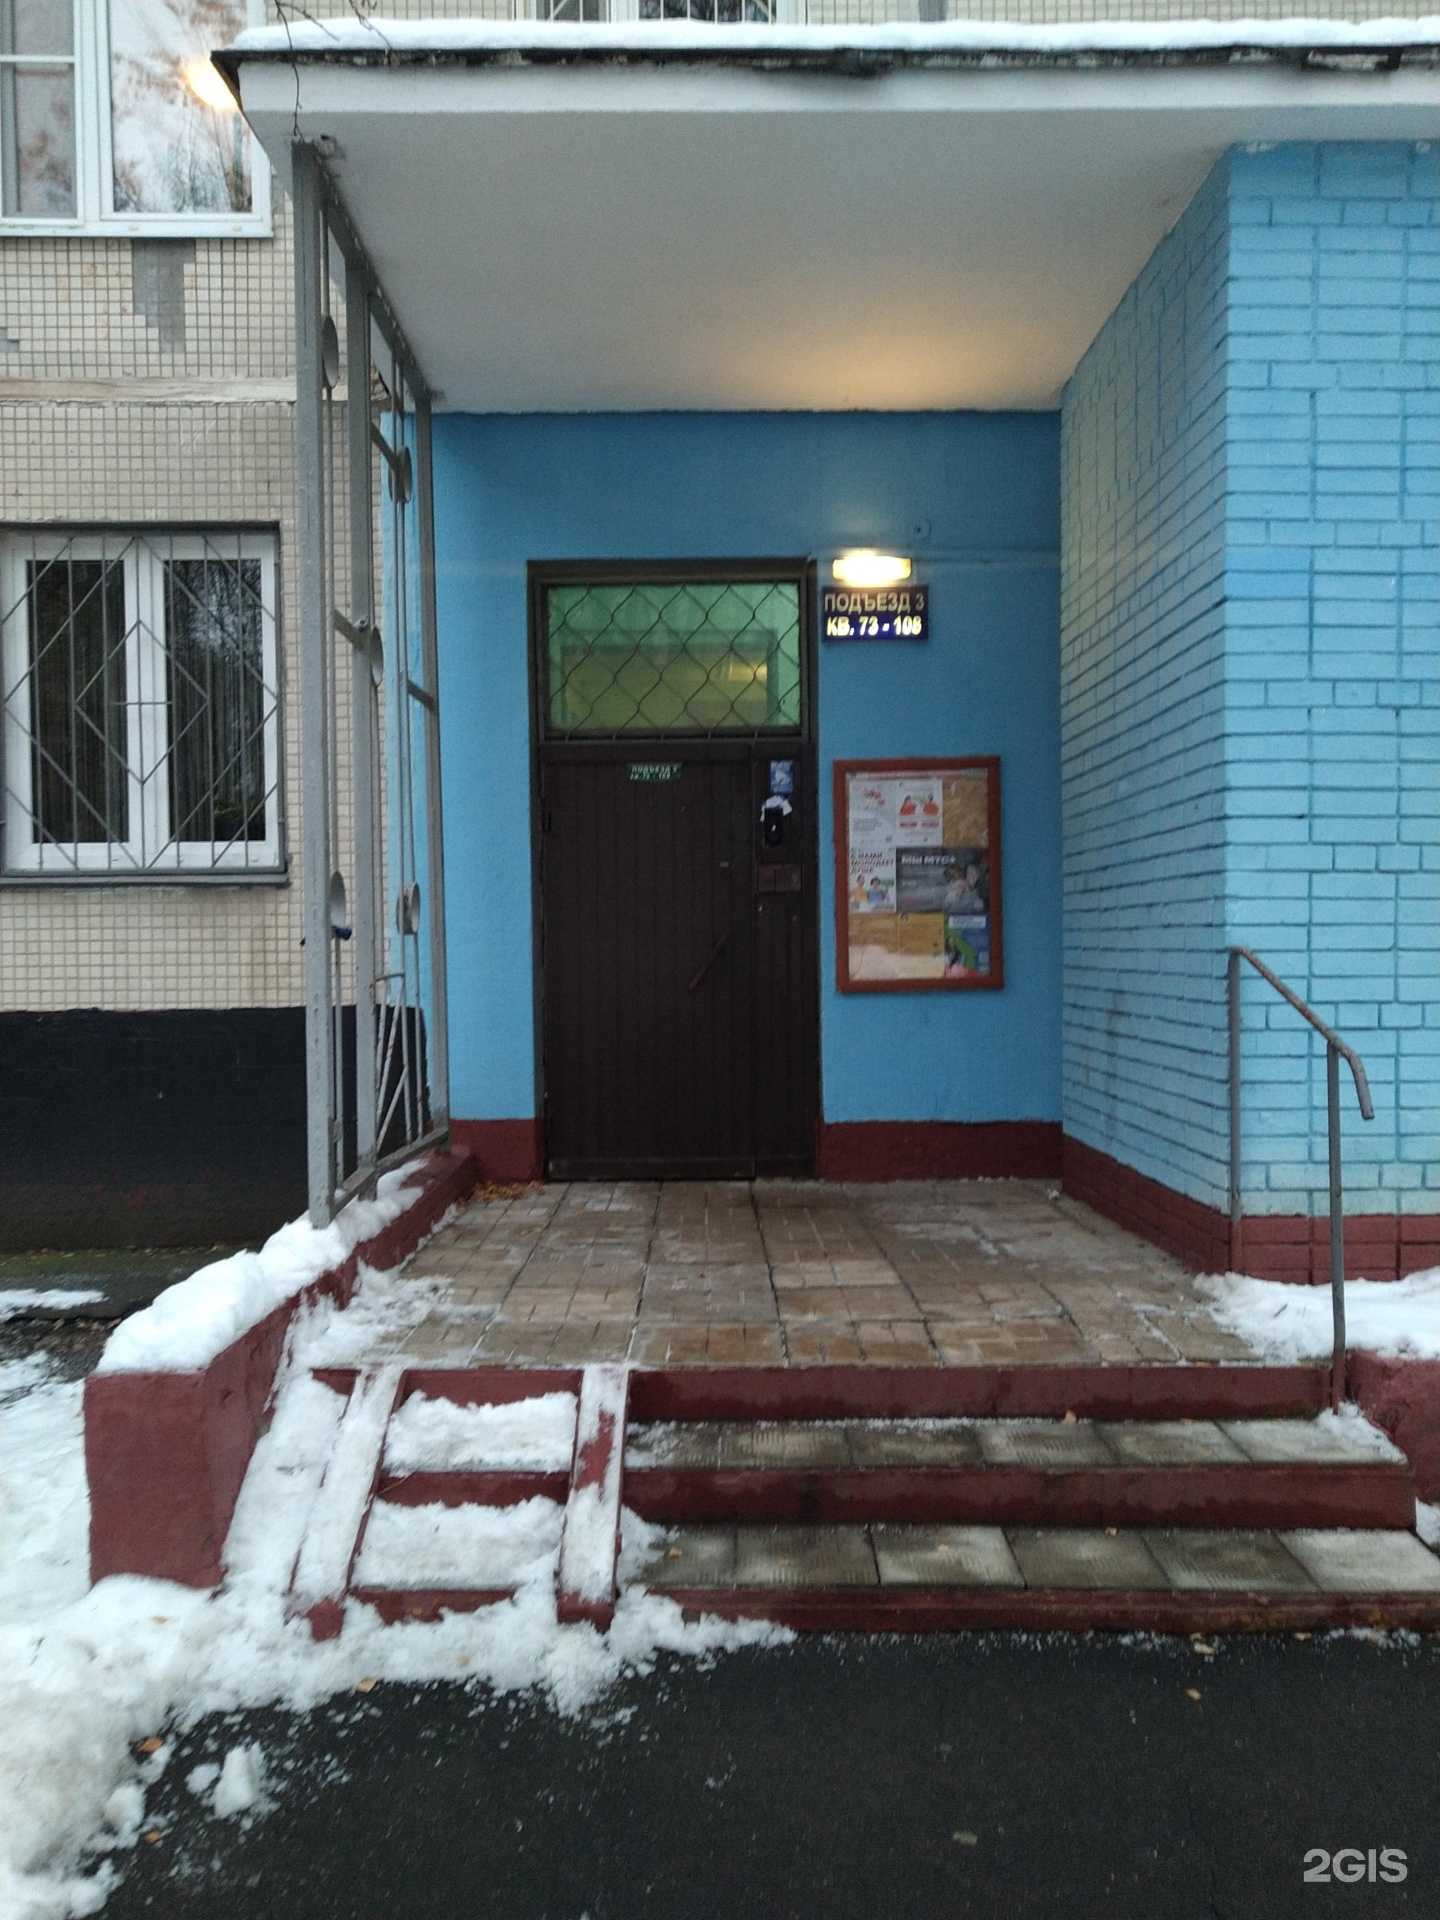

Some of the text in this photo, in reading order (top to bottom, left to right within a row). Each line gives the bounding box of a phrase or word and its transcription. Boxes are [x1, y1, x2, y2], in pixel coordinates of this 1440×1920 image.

[824, 592, 924, 615] ПОДЪЕЗД 3
[826, 616, 855, 636] КВ.
[859, 616, 879, 636] 73
